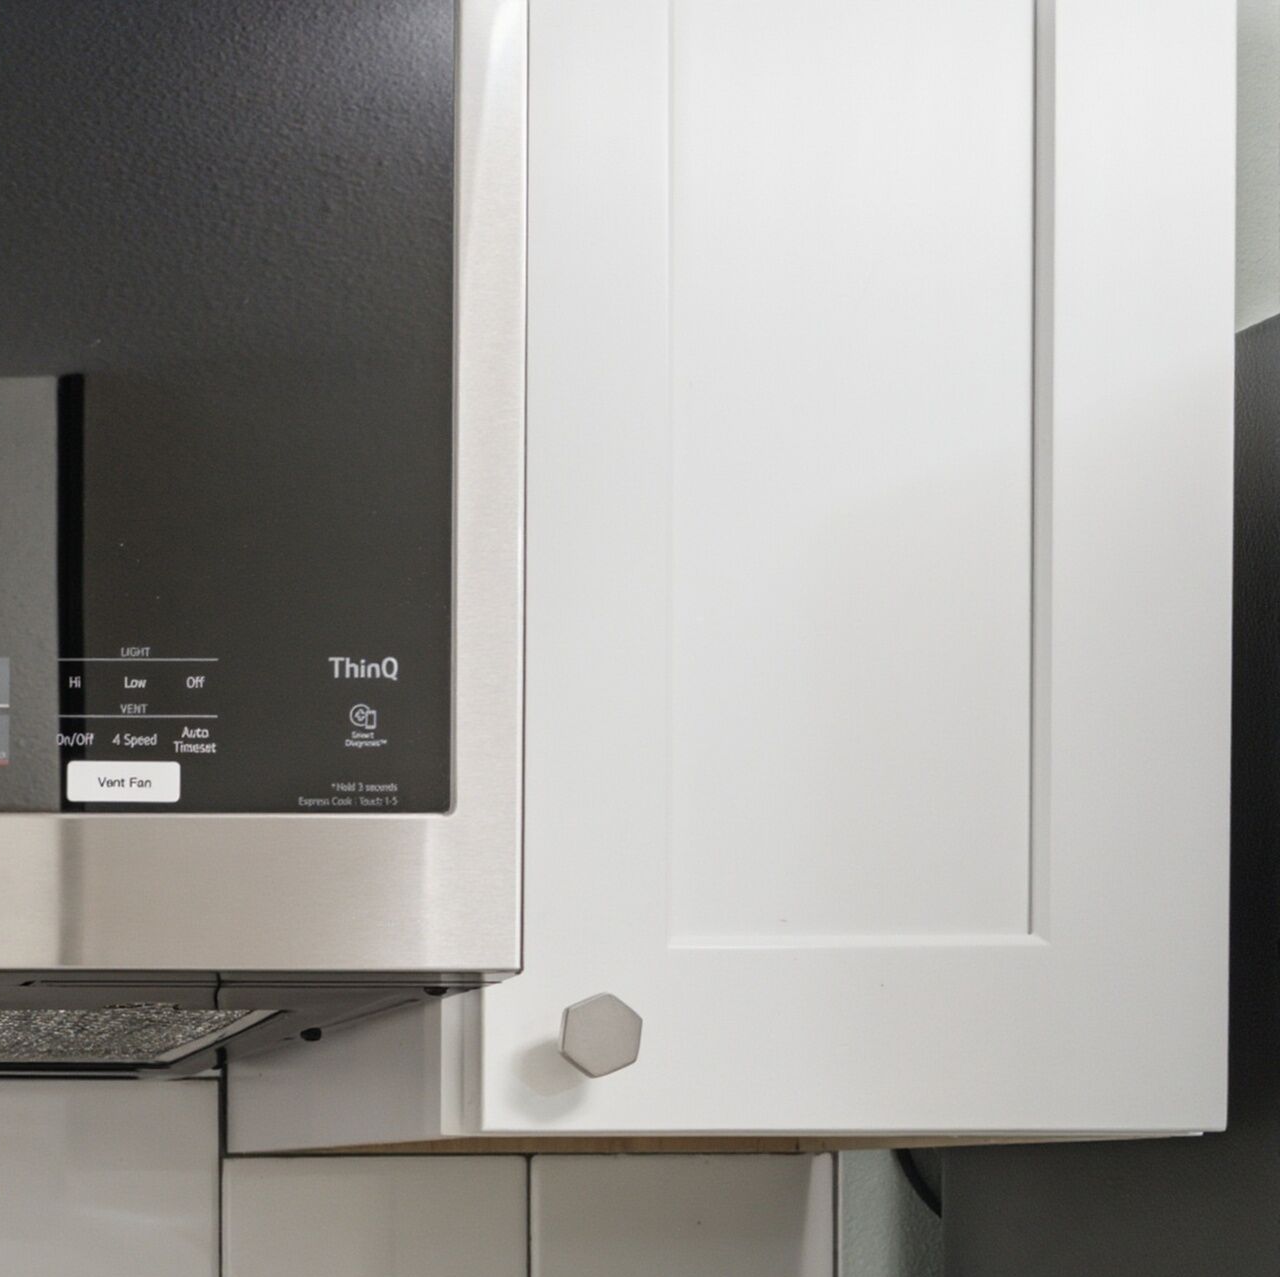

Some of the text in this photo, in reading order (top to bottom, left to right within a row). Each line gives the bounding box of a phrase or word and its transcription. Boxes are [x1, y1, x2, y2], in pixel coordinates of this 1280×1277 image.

[121, 647, 151, 657] LIGHT
[328, 657, 400, 682] ThinQ
[69, 676, 81, 688] Hi
[124, 676, 147, 688] Low
[186, 676, 205, 688] Off
[120, 704, 149, 714] VENT
[181, 726, 210, 739] Auto
[56, 733, 95, 747] On/Off
[112, 733, 158, 748] 4 Speed
[173, 741, 217, 753] Timeset
[97, 777, 152, 788] Vent Fan
